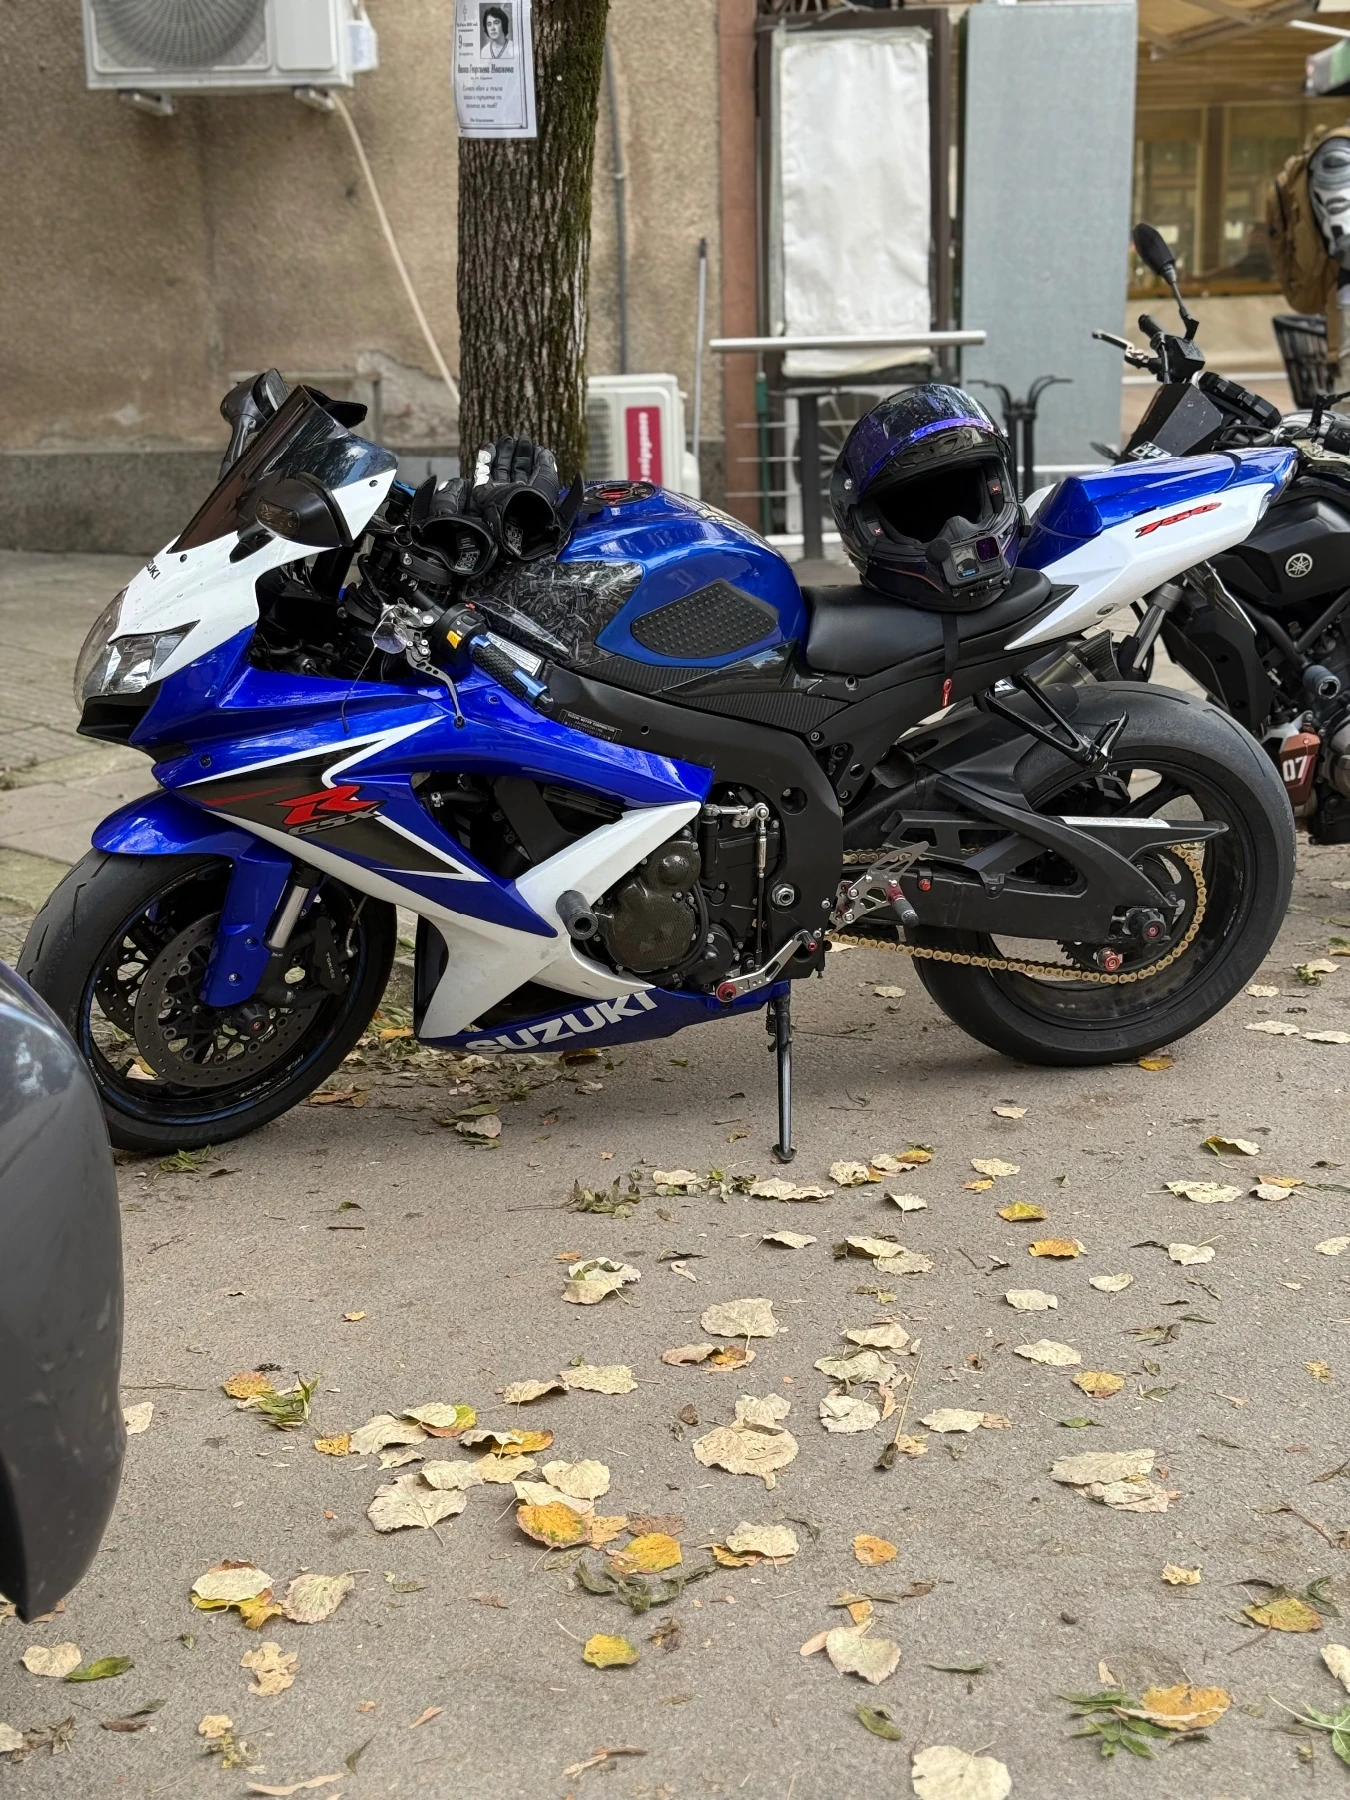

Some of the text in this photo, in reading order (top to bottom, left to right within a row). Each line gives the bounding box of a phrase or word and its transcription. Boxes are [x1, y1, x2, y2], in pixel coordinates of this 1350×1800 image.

[1135, 502, 1222, 539] 750
[1282, 755, 1308, 782] 07
[270, 784, 382, 825] R
[465, 991, 658, 1054] SUZUKI
